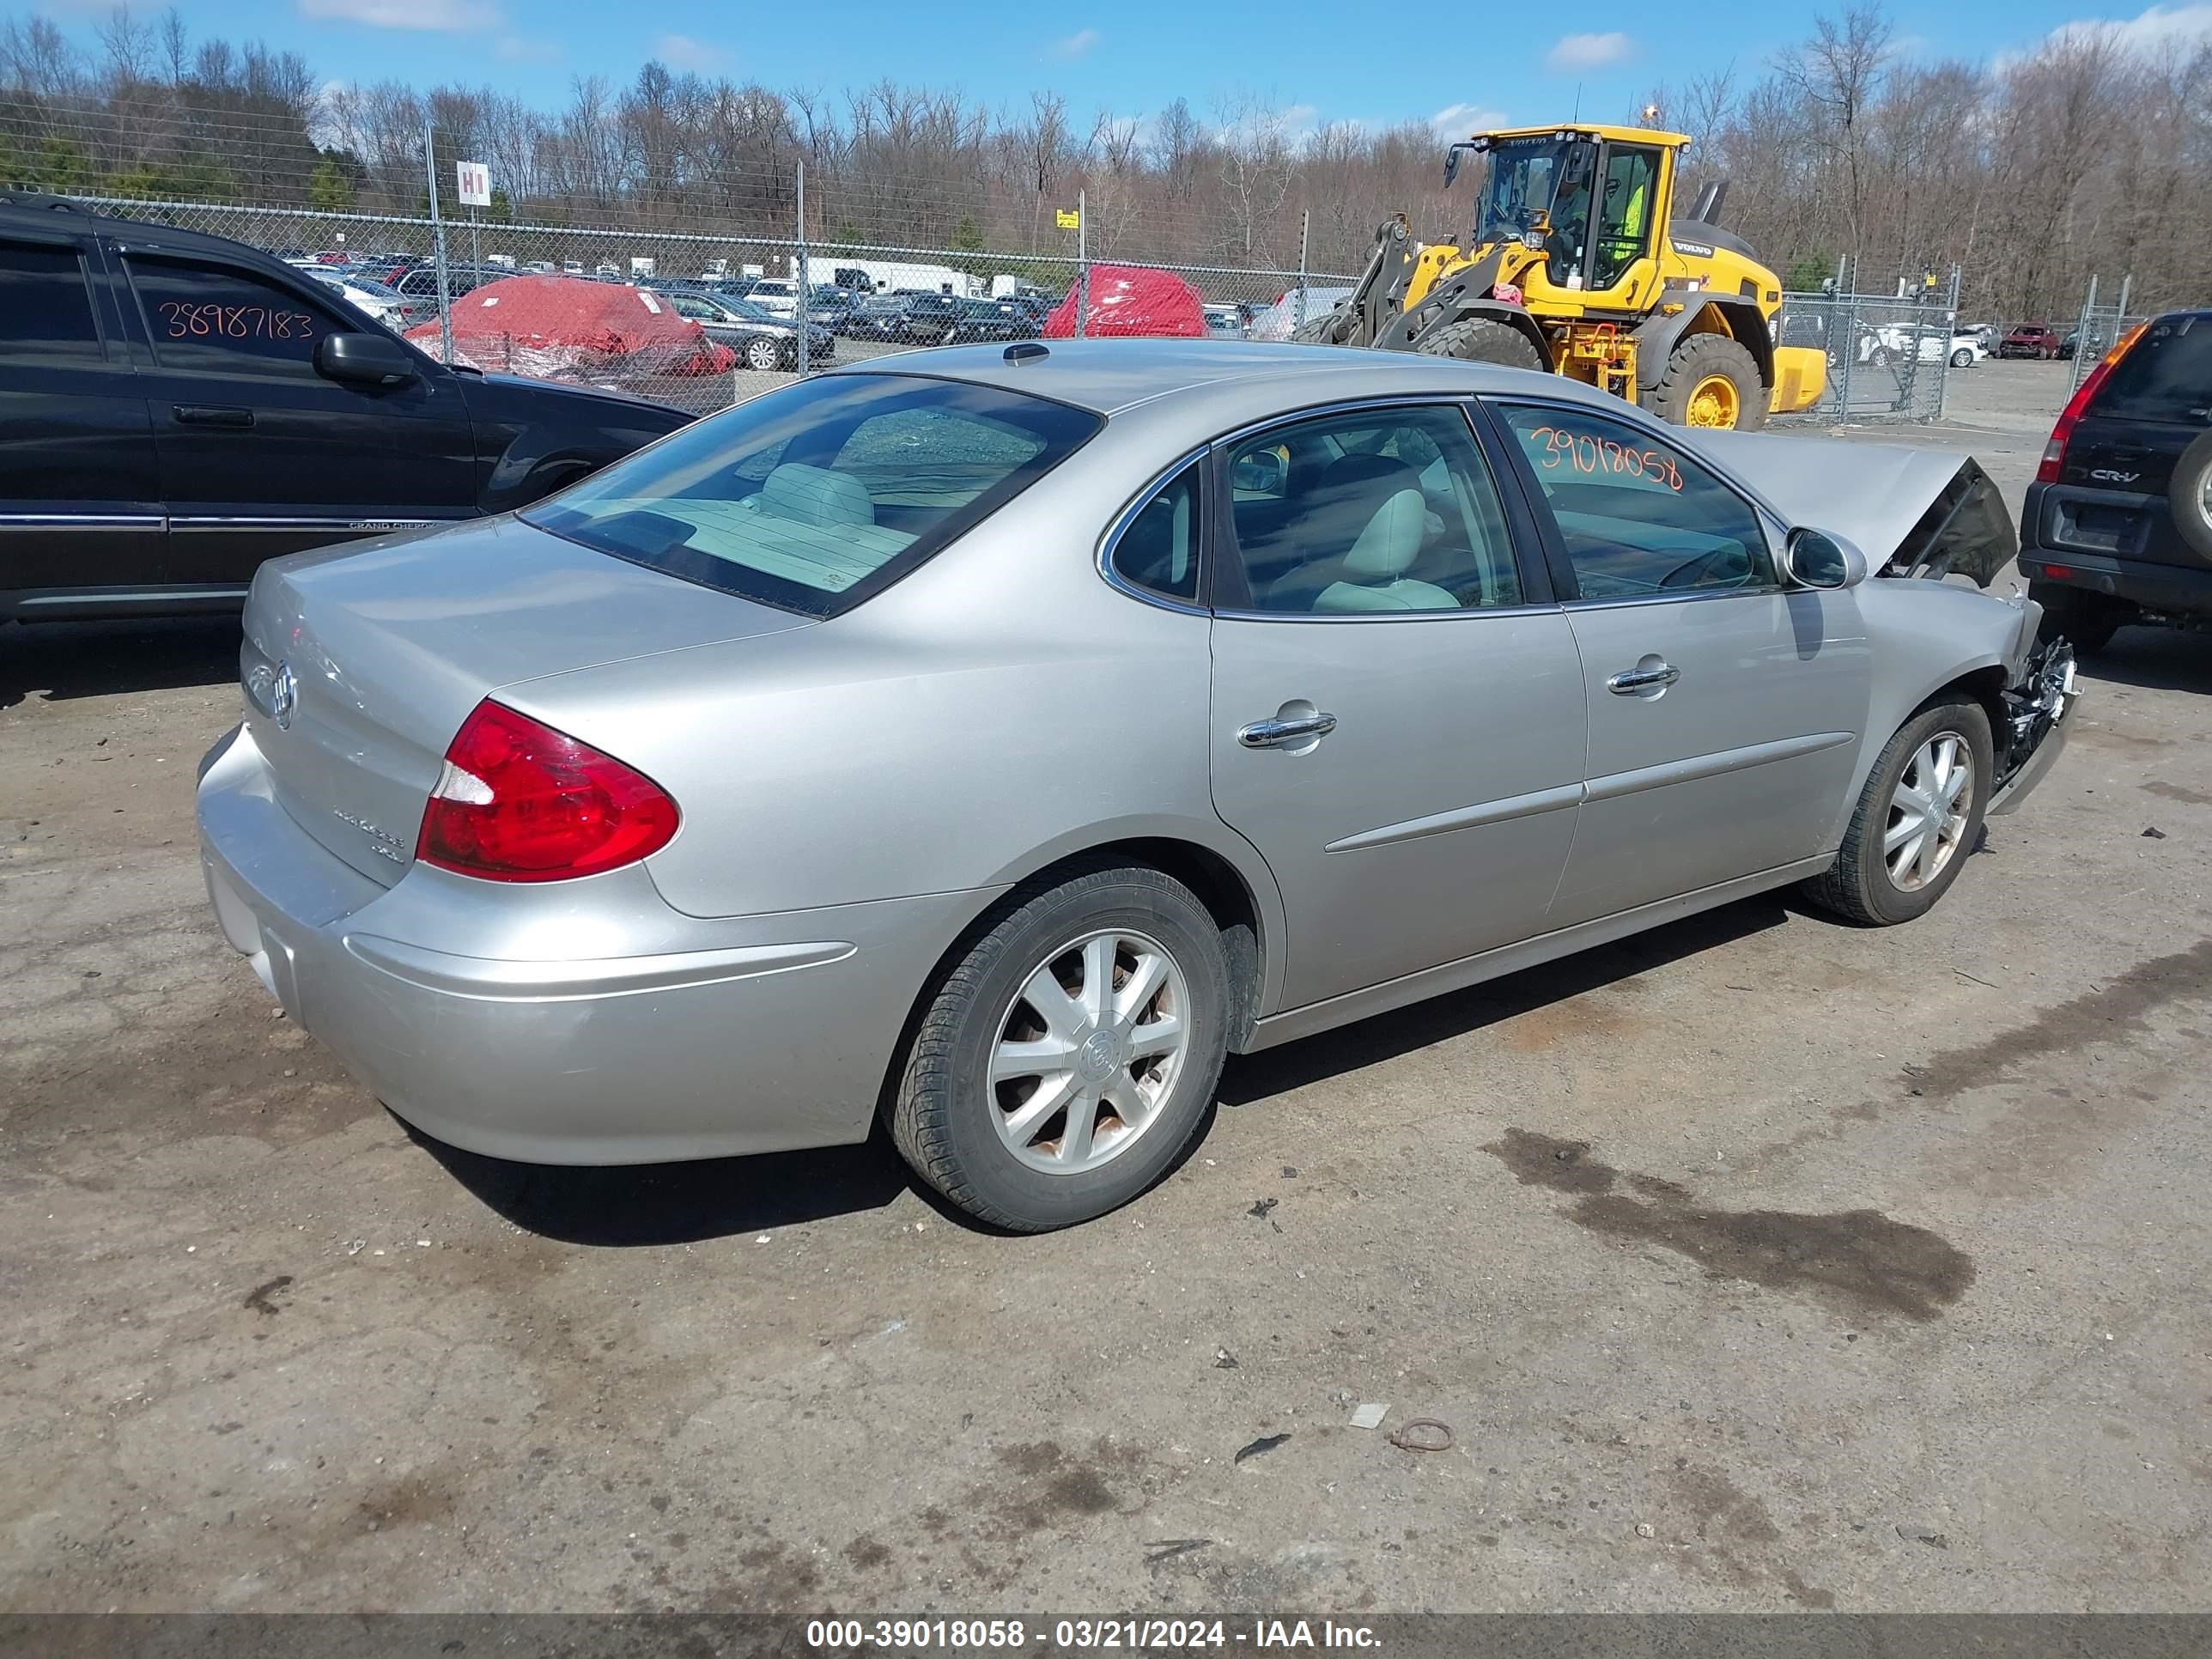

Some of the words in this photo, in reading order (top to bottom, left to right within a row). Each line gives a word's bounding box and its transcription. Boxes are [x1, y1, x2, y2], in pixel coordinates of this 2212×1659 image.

[1510, 137, 1547, 147] VOLVO
[1674, 241, 1712, 255] VOLVO
[159, 302, 313, 338] 38987183
[1531, 427, 1683, 490] 39018058
[2090, 469, 2142, 483] CR-V
